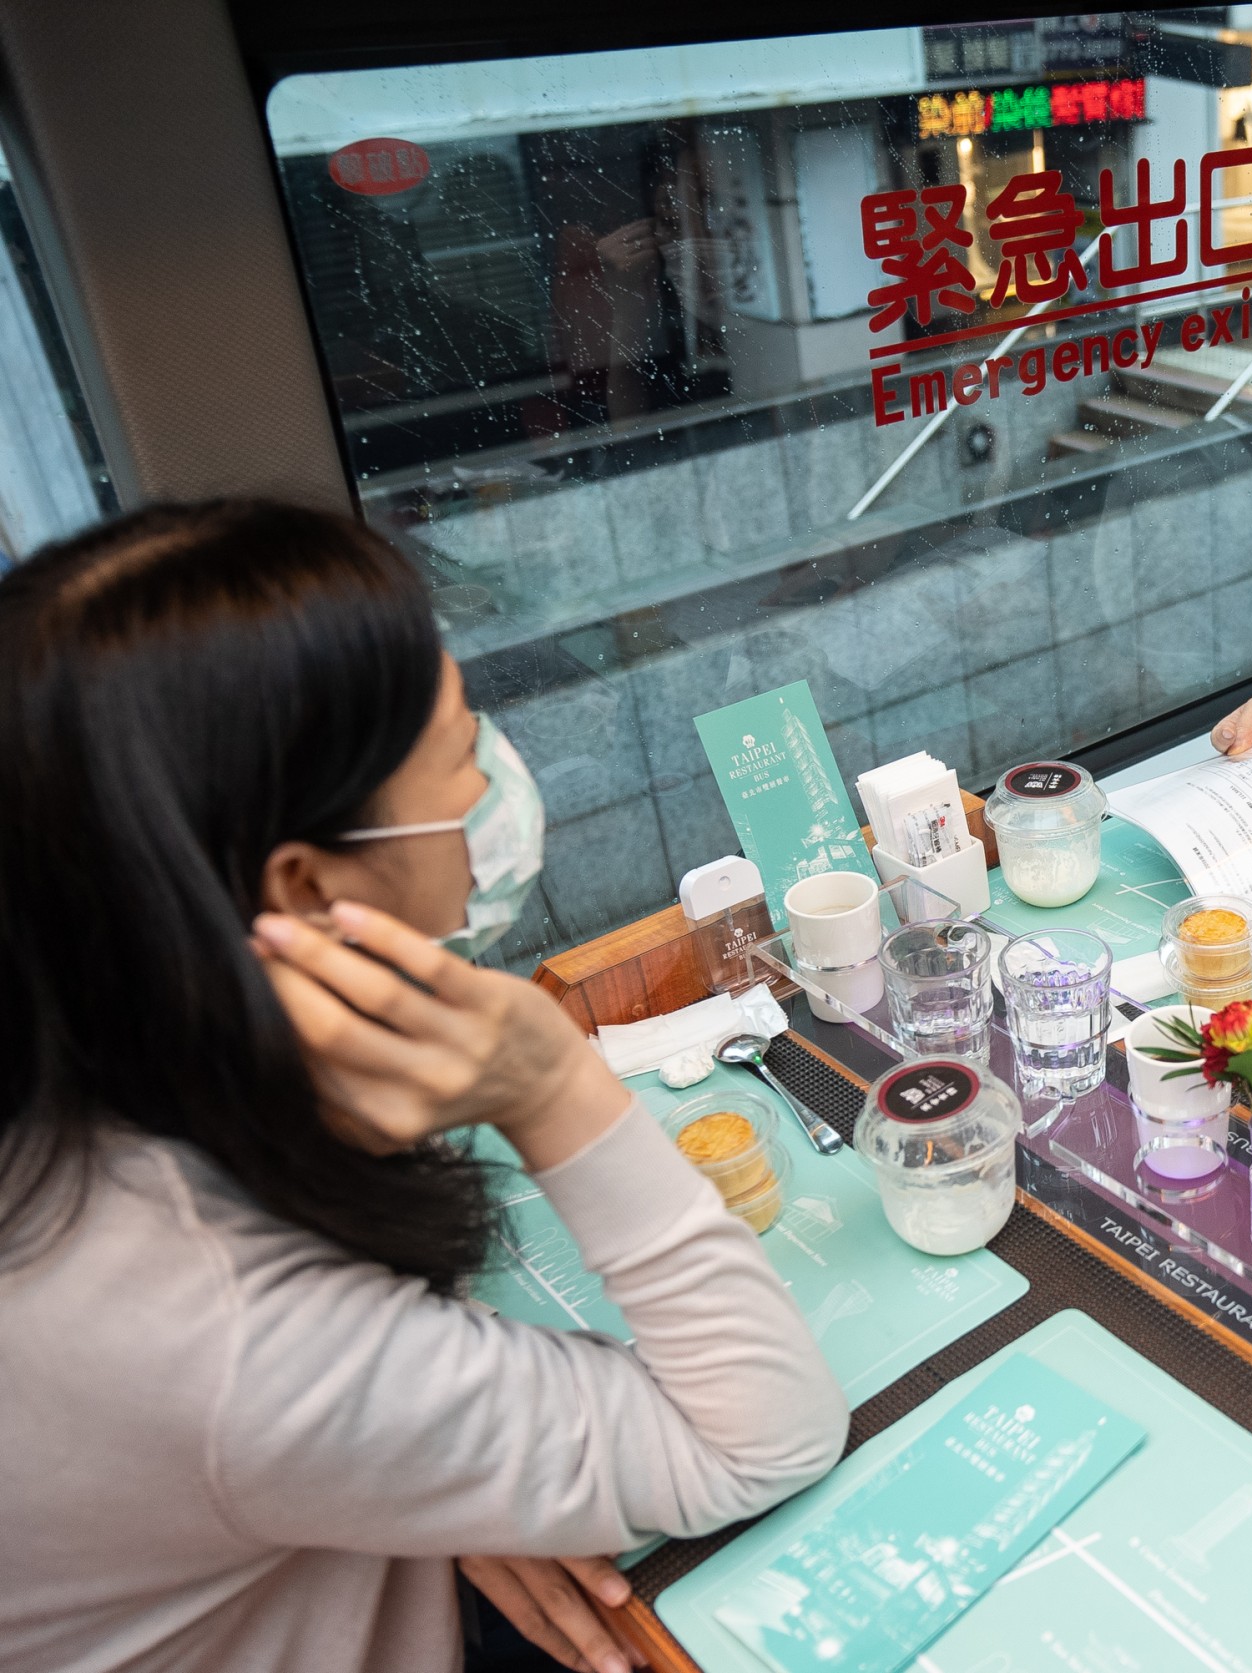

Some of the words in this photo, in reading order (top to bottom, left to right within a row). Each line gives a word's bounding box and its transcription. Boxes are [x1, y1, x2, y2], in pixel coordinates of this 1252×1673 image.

[870, 321, 1164, 427] Emergency
[728, 751, 786, 780] RESTAURANT
[731, 742, 776, 767] TAIPEI
[753, 770, 770, 783] BUS
[725, 931, 757, 951] TAIPEI
[1100, 1217, 1160, 1262] TAIPEI
[982, 1403, 1042, 1453] TAIPEI
